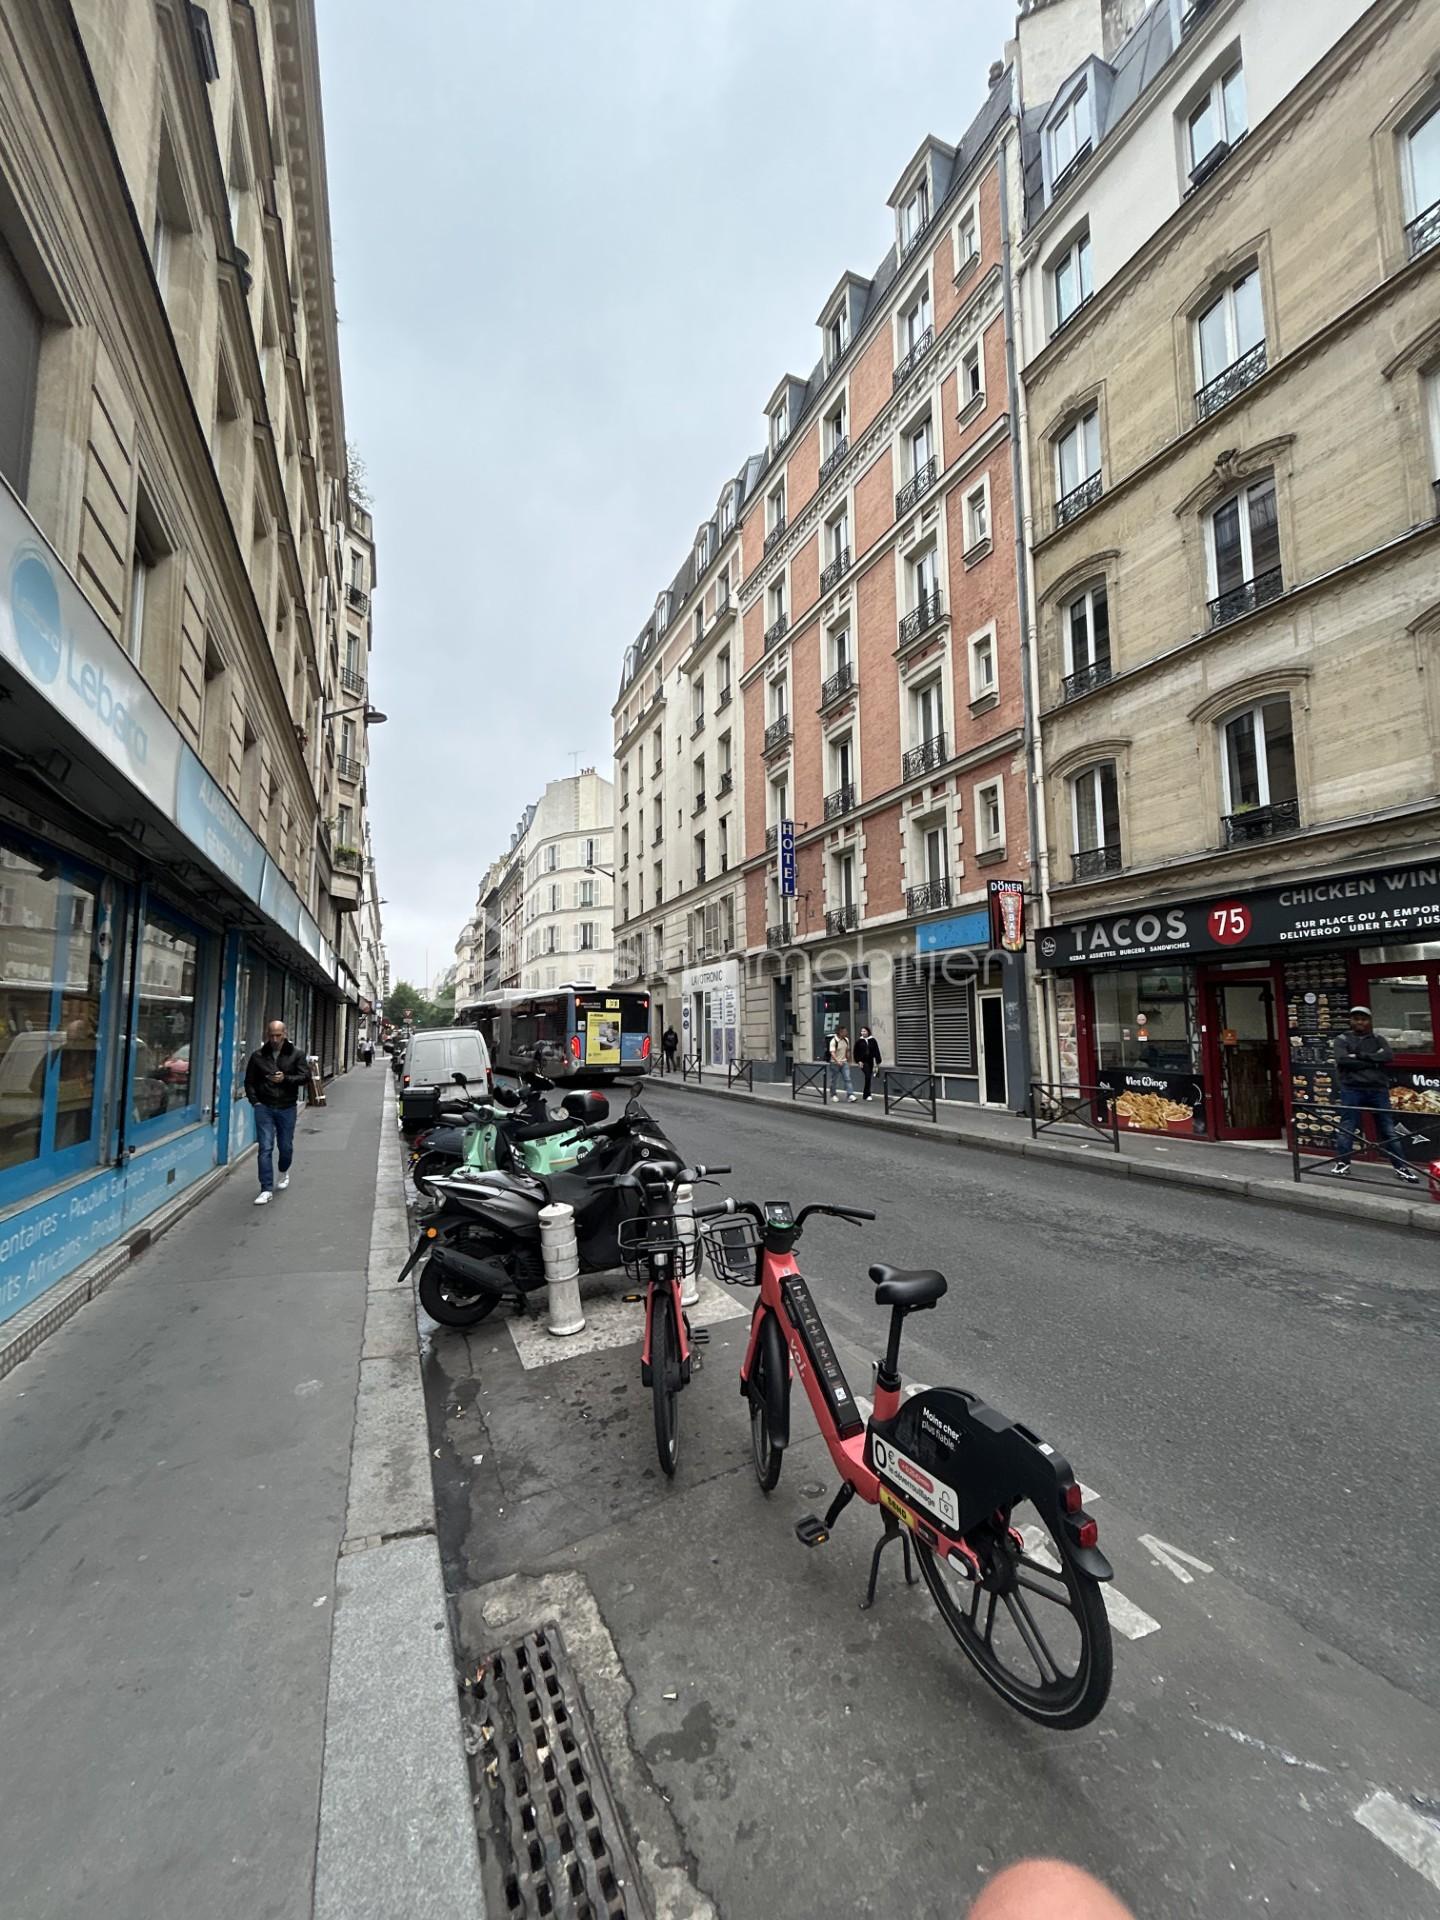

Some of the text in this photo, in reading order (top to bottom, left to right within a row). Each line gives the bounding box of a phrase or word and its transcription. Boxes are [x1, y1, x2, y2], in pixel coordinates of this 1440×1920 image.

[67, 628, 148, 766] Lebara
[782, 823, 793, 894] HOTEL
[991, 881, 1023, 892] DÖNER
[1279, 868, 1440, 906] CHICKEN WIN
[1214, 908, 1245, 936] 75
[1280, 915, 1440, 940] DELIVEROO UBER EAT JUS
[1295, 919, 1316, 928] SUR
[1320, 914, 1354, 927] PLACE
[1358, 912, 1376, 921] OU
[1393, 904, 1440, 917] EMPOR
[1071, 909, 1187, 951] TACOS
[1119, 947, 1146, 956] BURGERS
[1149, 942, 1190, 952] SANDWICHES
[1141, 1076, 1168, 1090] Wings
[1412, 1074, 1440, 1087] Nos
[921, 1420, 936, 1436] plus
[922, 1407, 942, 1429] Moins
[875, 1440, 887, 1469] 0
[887, 1450, 896, 1465] €
